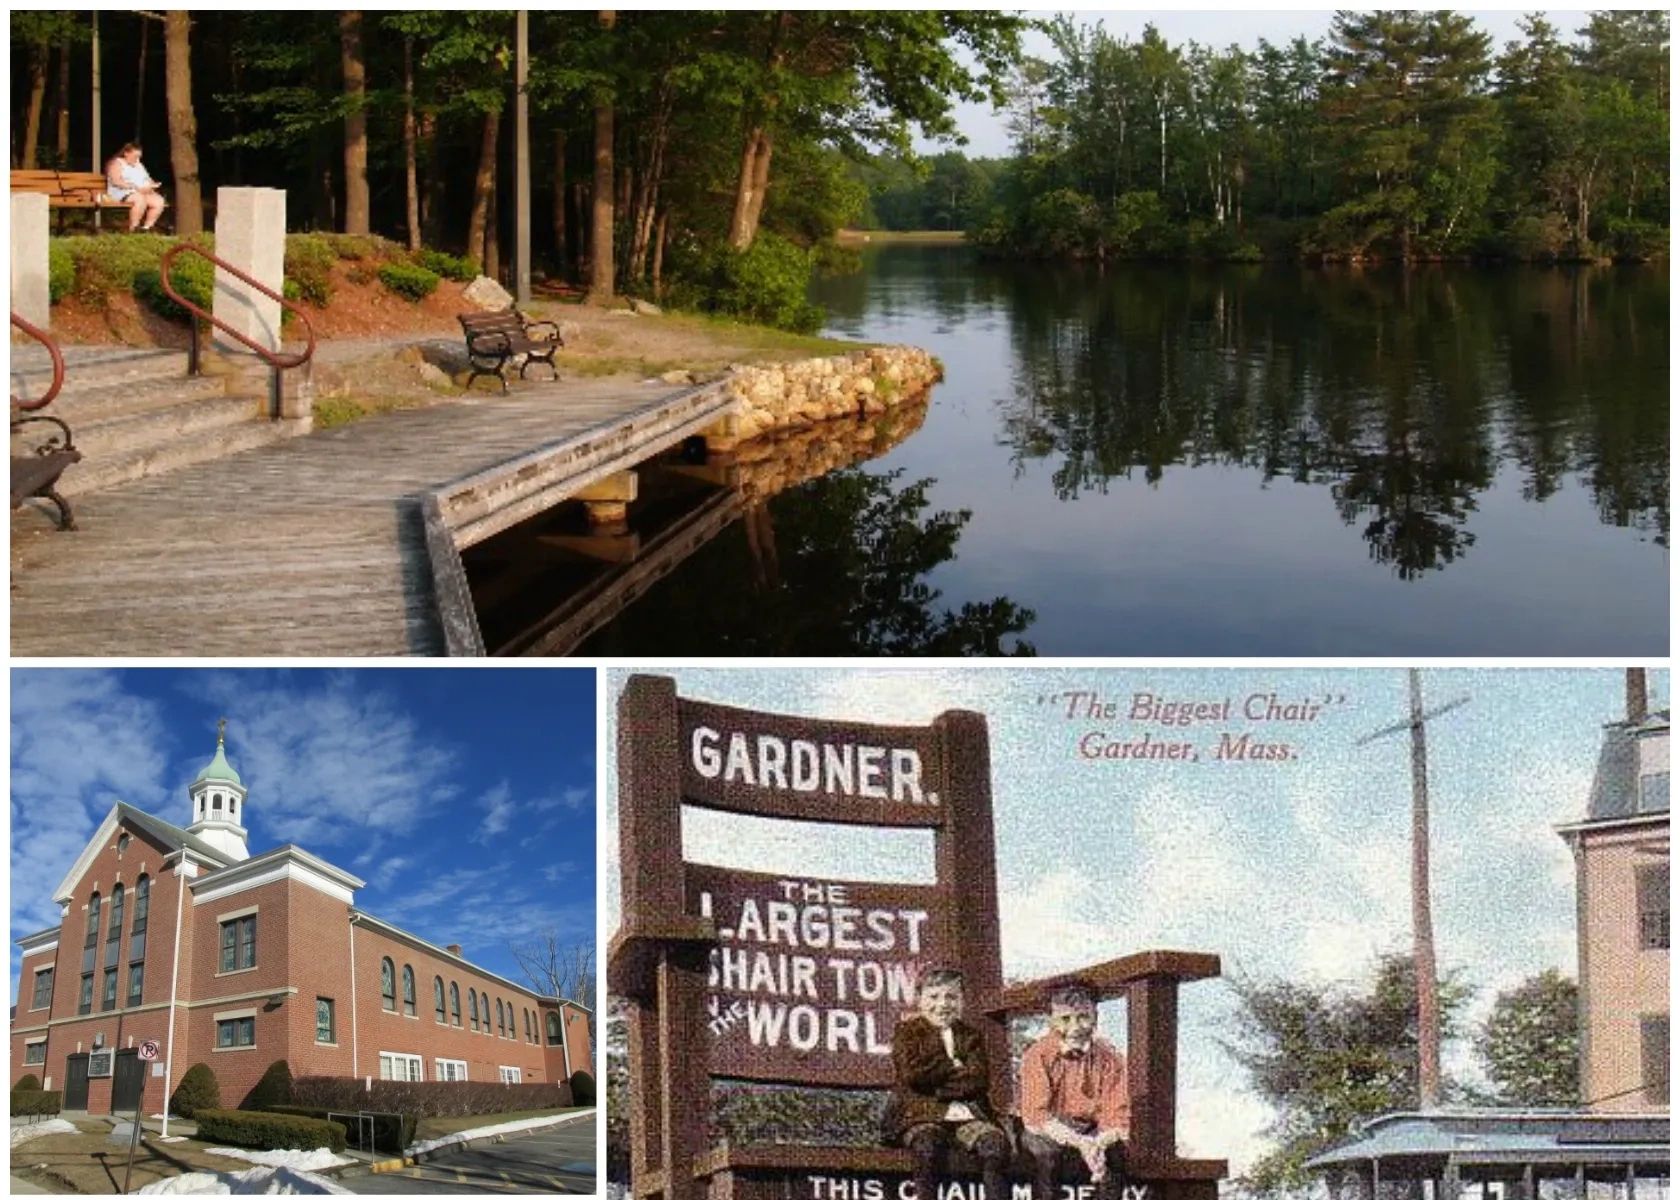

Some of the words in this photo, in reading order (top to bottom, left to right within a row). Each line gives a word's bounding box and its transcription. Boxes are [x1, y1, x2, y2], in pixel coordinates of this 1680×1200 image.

[692, 726, 940, 806] GARDNER.
[777, 880, 850, 904] THE
[828, 958, 918, 1006] TOW
[749, 1000, 893, 1055] WORL
